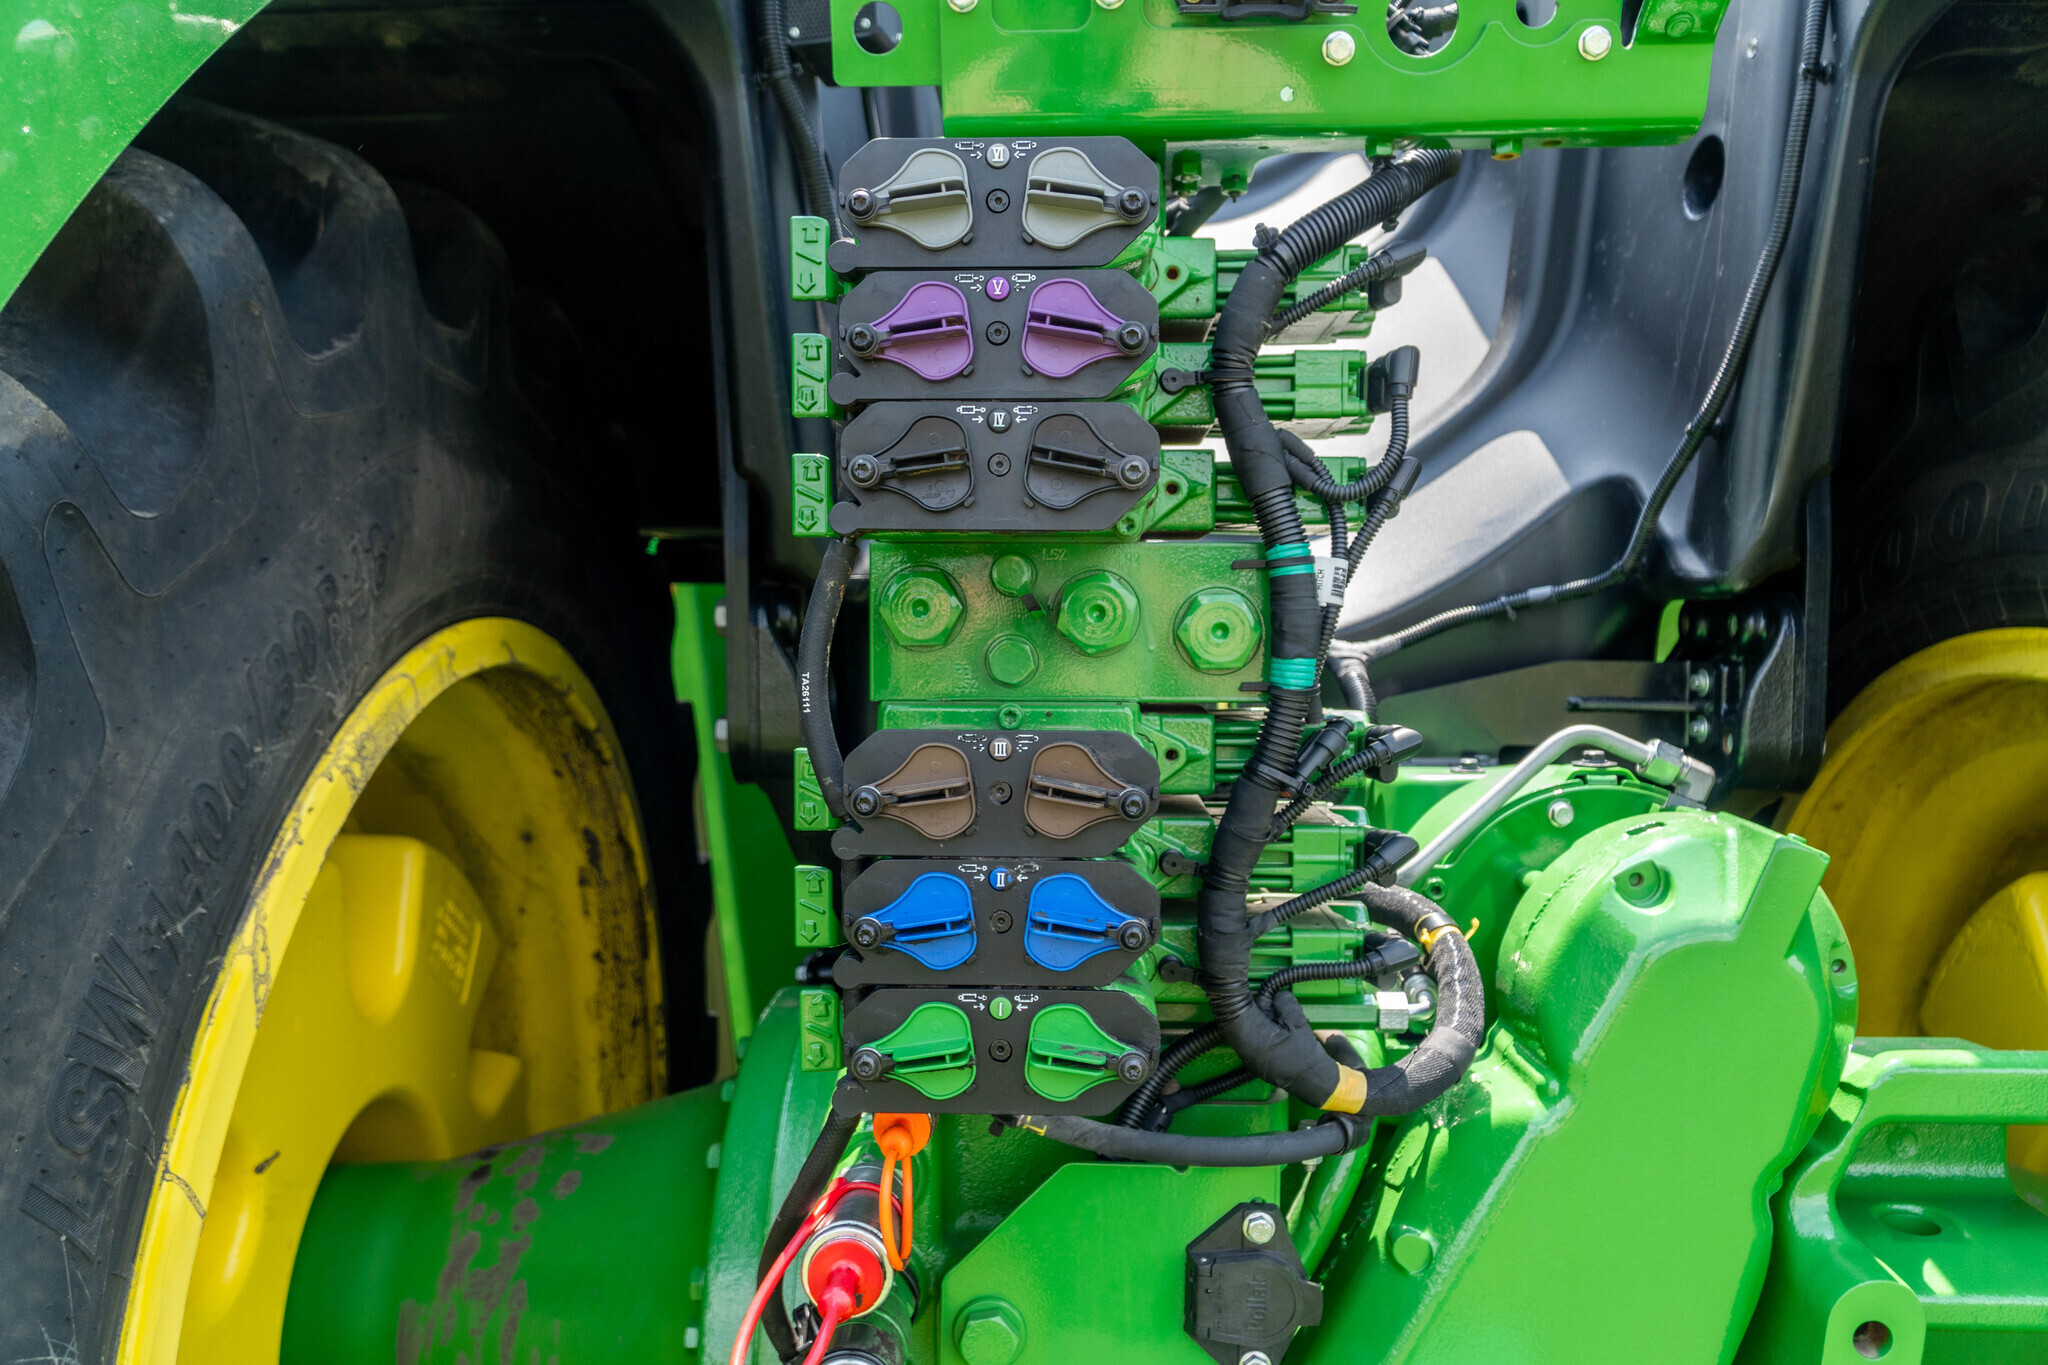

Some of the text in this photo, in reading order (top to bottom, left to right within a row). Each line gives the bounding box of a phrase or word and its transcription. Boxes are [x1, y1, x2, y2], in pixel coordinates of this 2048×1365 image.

[991, 147, 1005, 162] VI
[992, 279, 1004, 295] V
[993, 412, 1006, 427] IV
[801, 671, 812, 714] TA26111
[994, 742, 1007, 757] III
[996, 872, 1006, 888] II
[19, 931, 163, 1259] LSW
